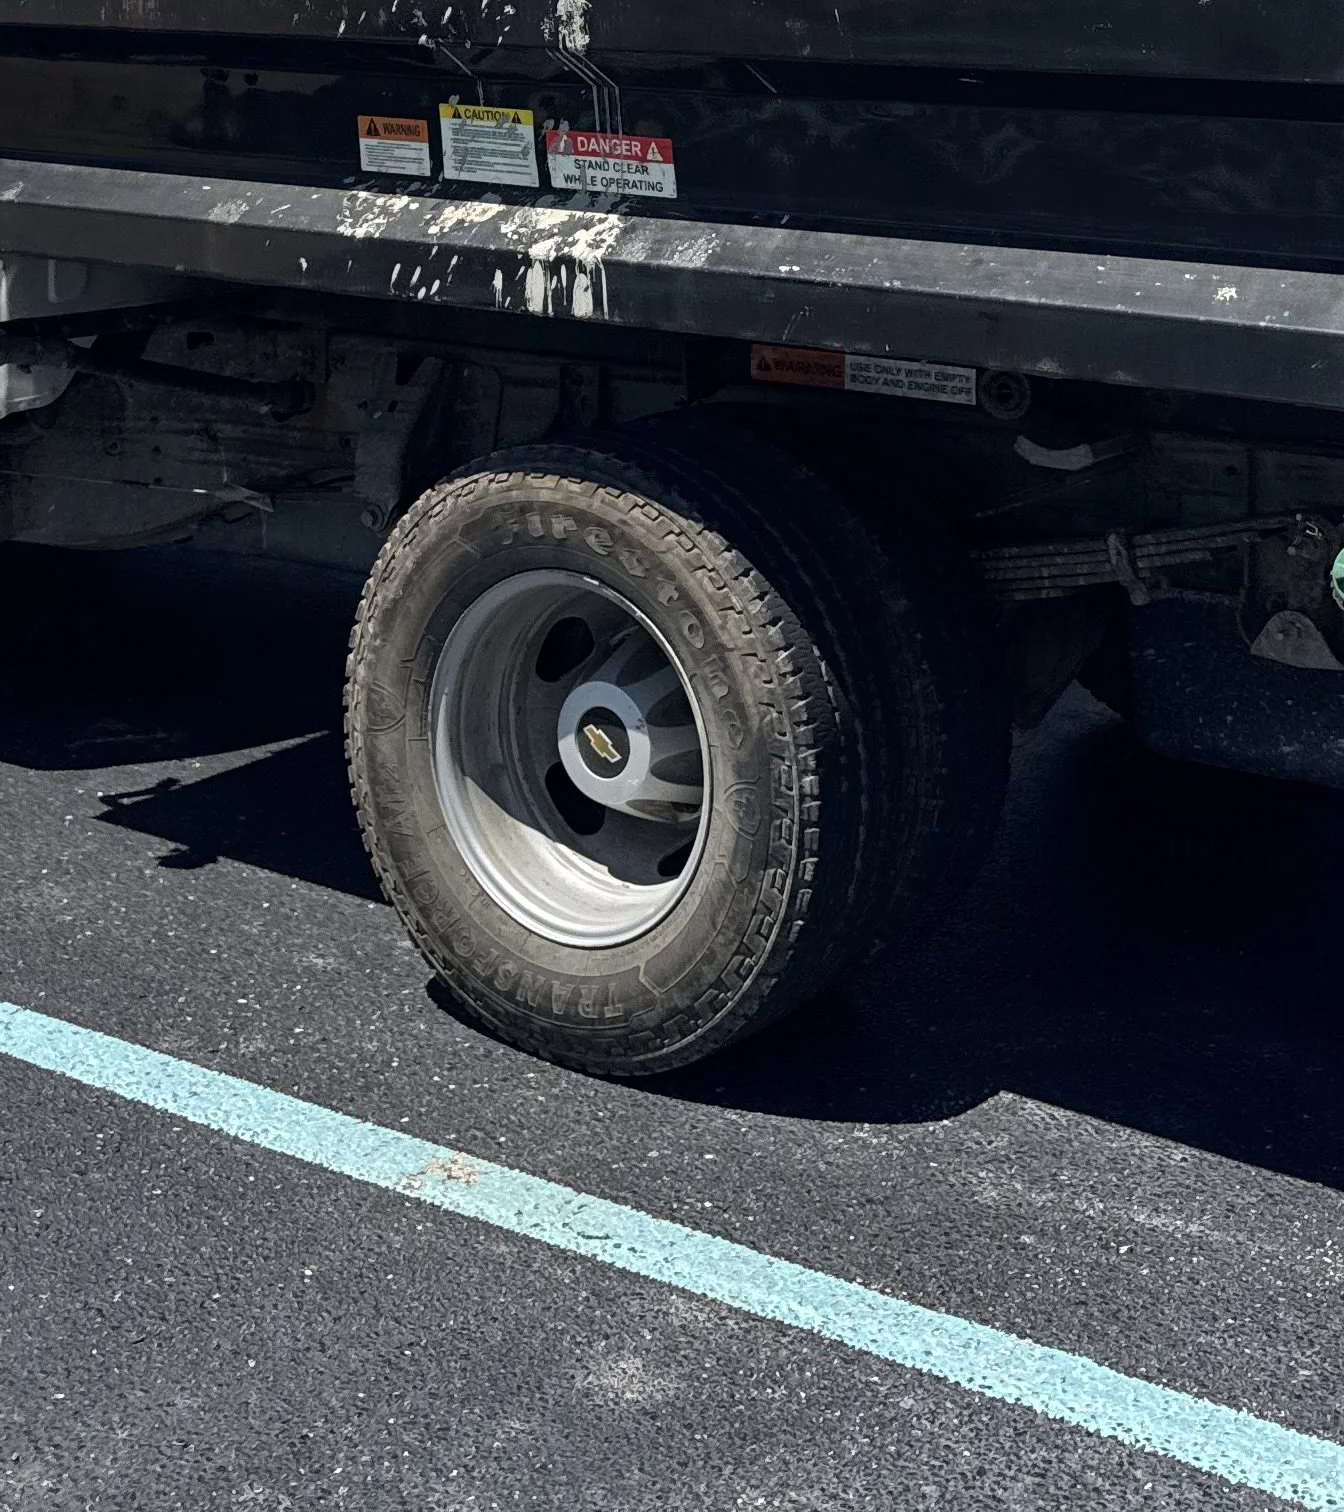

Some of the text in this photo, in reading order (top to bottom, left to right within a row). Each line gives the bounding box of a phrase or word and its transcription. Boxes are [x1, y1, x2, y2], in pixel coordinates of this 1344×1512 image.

[577, 136, 642, 157] DANGER
[573, 158, 650, 175] STAND CLEAR
[562, 173, 664, 192] WHLE OPERATING
